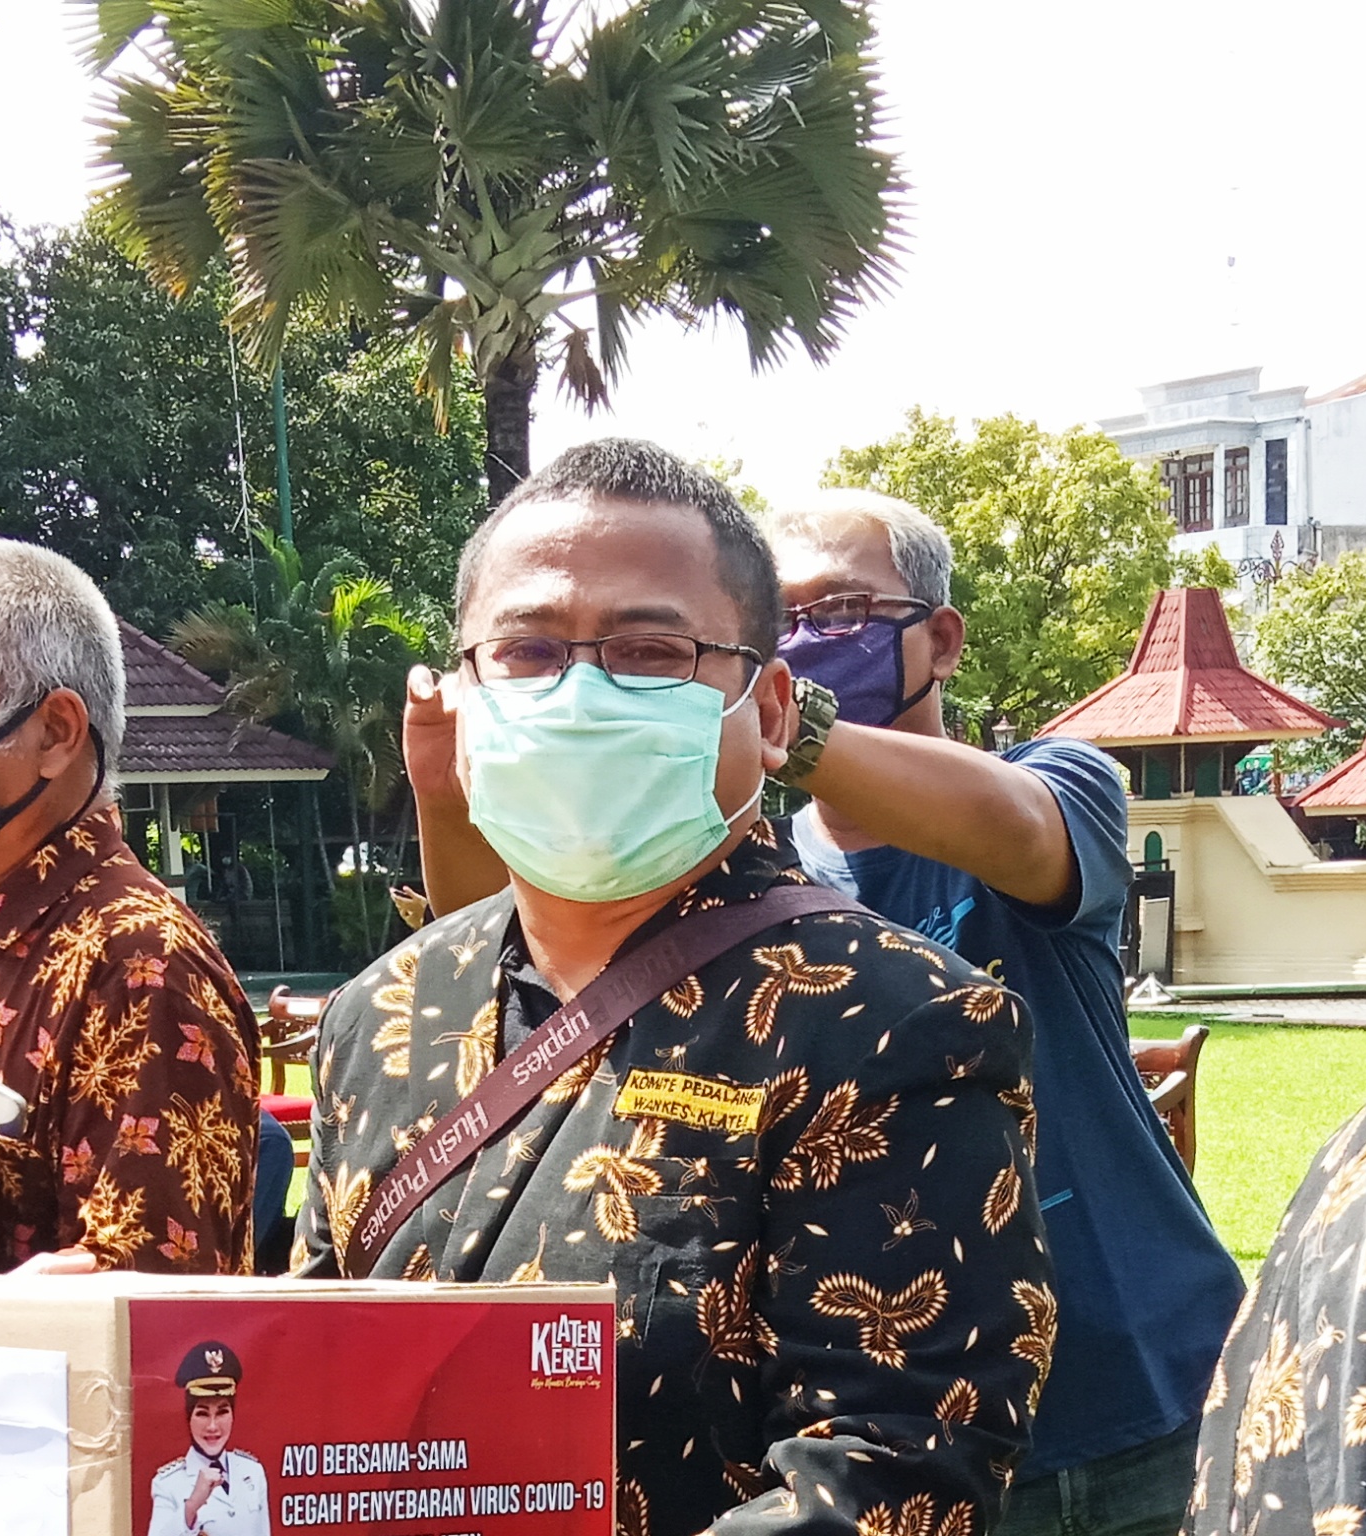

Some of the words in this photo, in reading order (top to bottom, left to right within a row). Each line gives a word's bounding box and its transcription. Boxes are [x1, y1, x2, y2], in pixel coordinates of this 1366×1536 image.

[428, 1101, 490, 1166] Hush
[360, 1157, 431, 1251] Puppies
[281, 1445, 317, 1476] AYO
[322, 1440, 467, 1475] BERSAMA-SAMA
[281, 1493, 342, 1526] CEGAH
[347, 1487, 465, 1522] PENYEBARAN
[470, 1484, 521, 1515] VIRUS
[524, 1480, 605, 1513] COVID-19
